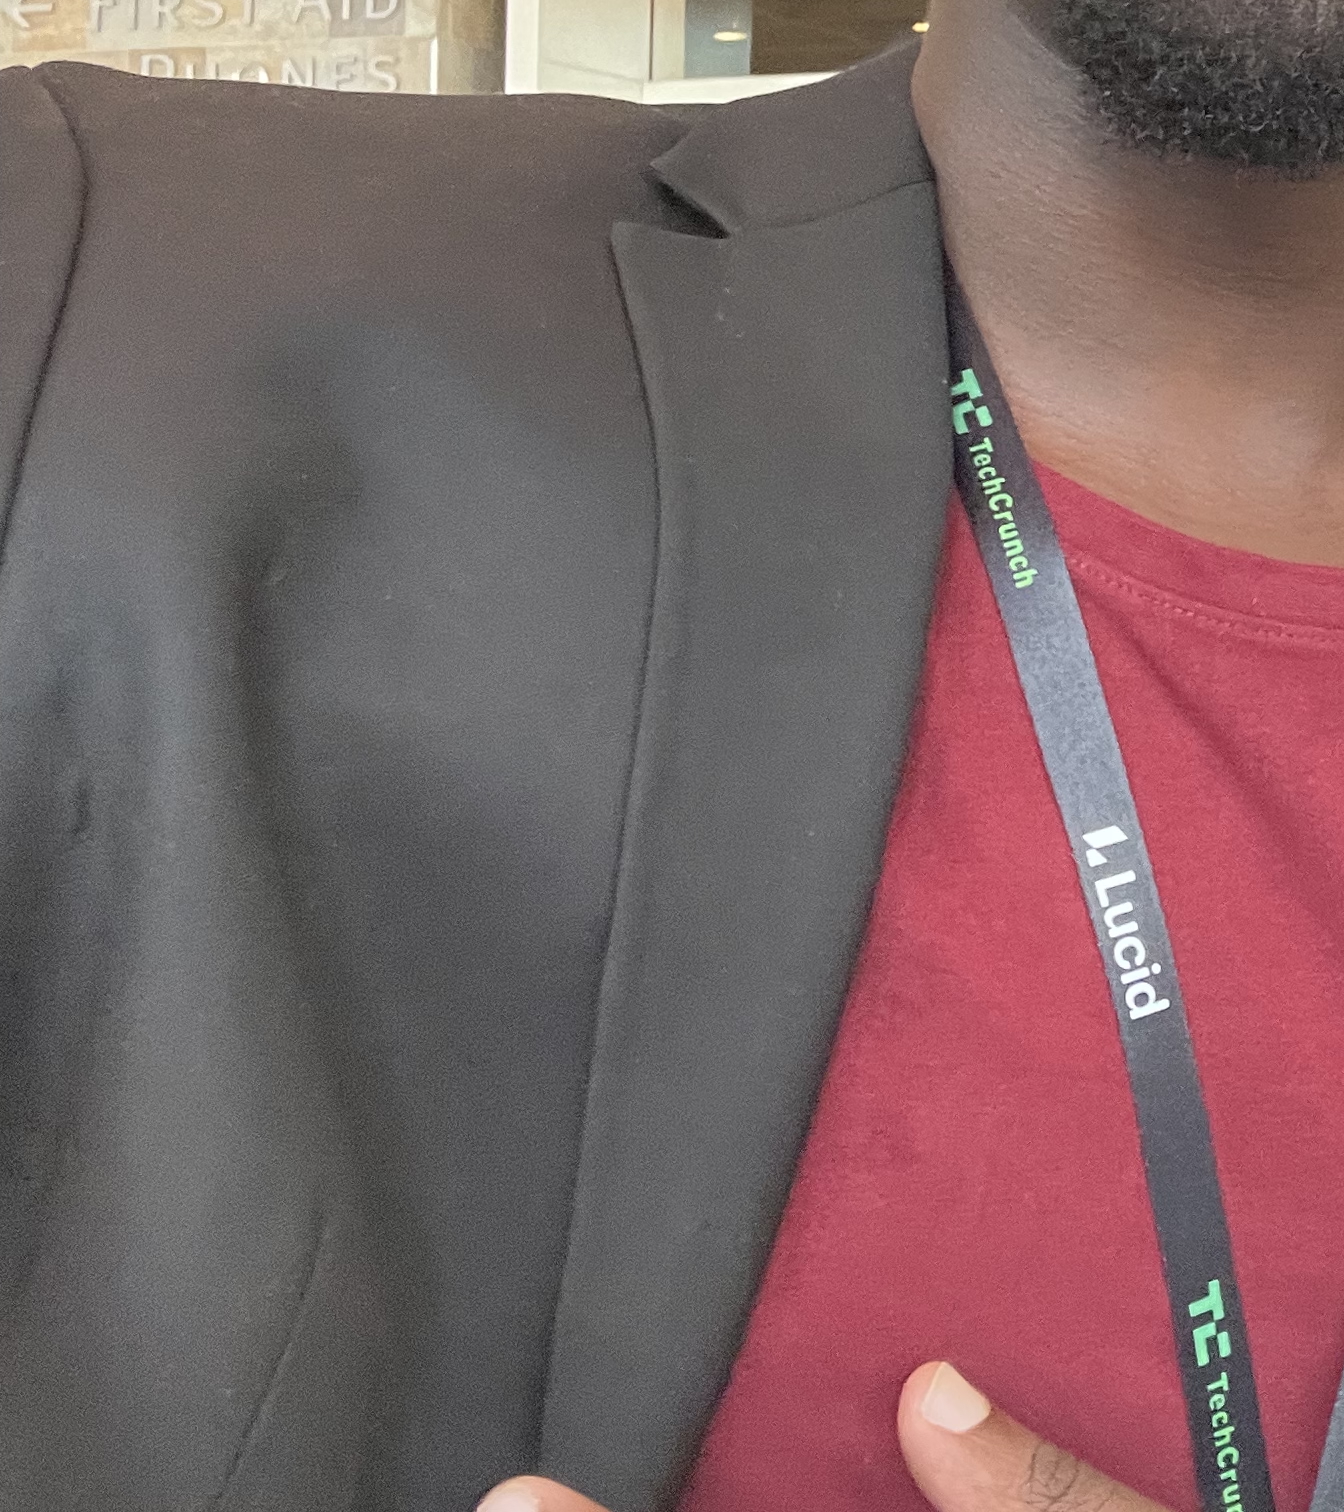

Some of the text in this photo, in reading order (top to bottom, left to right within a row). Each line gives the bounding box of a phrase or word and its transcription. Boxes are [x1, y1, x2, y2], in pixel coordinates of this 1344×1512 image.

[951, 368, 1037, 589] TC TechCrunch
[1094, 869, 1171, 1021] Lucid
[1187, 1279, 1232, 1367] TC
